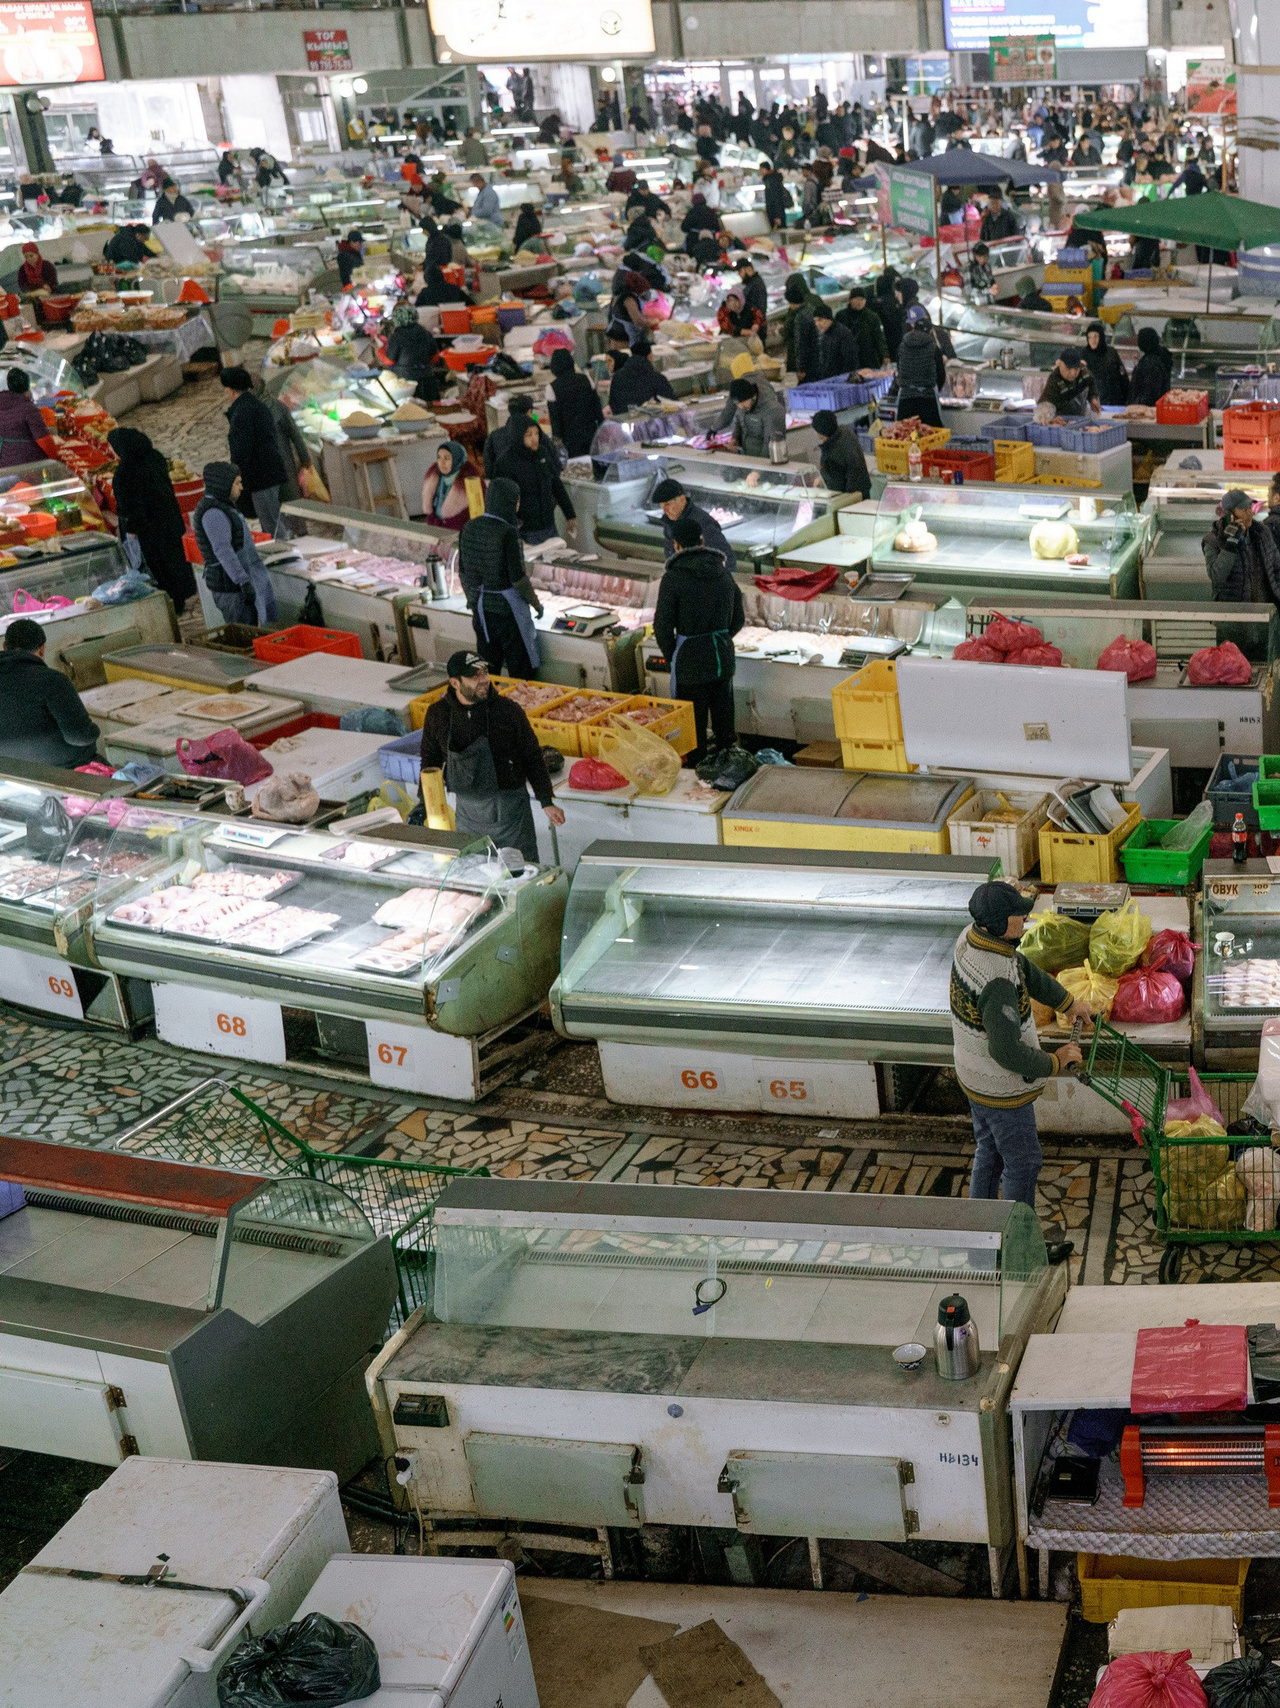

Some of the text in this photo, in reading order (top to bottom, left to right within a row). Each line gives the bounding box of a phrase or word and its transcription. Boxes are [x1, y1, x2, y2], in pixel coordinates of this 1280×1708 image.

[48, 976, 74, 998] 69
[217, 1013, 247, 1036] 68
[377, 1043, 408, 1067] 67
[681, 1069, 718, 1091] 66
[769, 1080, 807, 1100] 65
